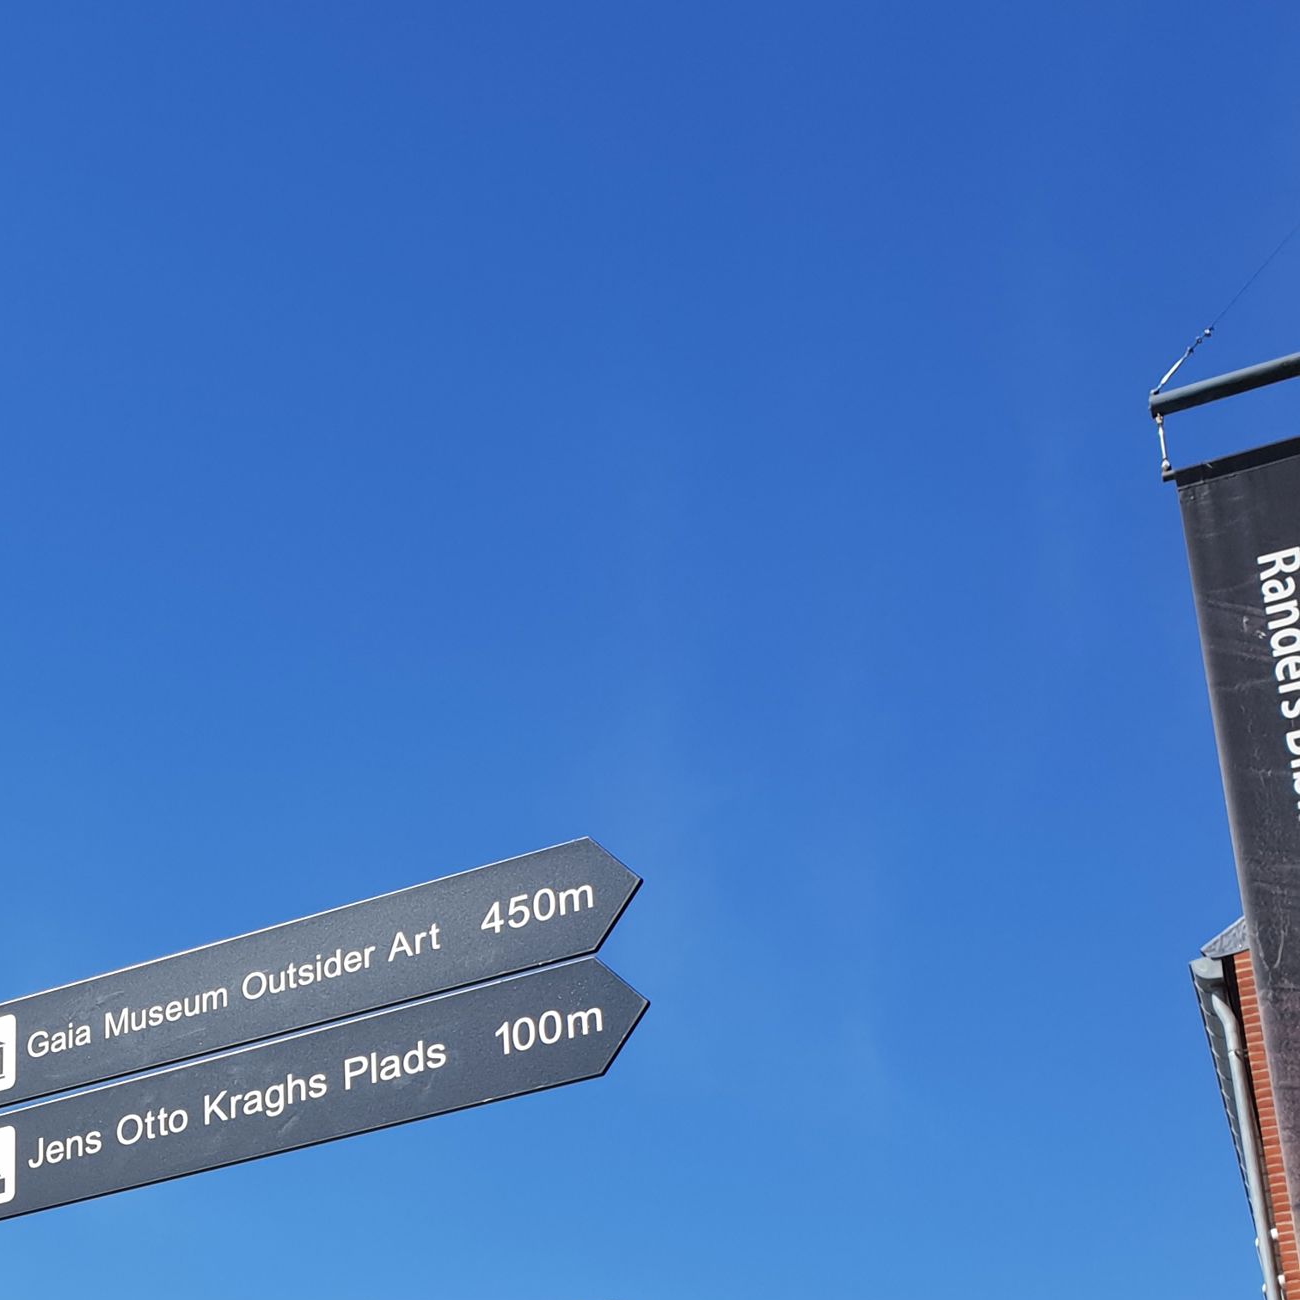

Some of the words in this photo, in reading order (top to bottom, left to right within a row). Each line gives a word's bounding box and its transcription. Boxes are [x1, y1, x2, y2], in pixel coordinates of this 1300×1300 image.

[26, 1021, 92, 1058] Gaia
[104, 986, 229, 1040] Museum
[241, 945, 377, 1000] Outsider
[387, 921, 444, 963] Art
[480, 883, 595, 934] 450m
[27, 1130, 103, 1169] Jens
[116, 1106, 189, 1146] Otto
[203, 1073, 328, 1126] Kraghs
[343, 1039, 448, 1091] Plads
[494, 1007, 604, 1056] 100m
